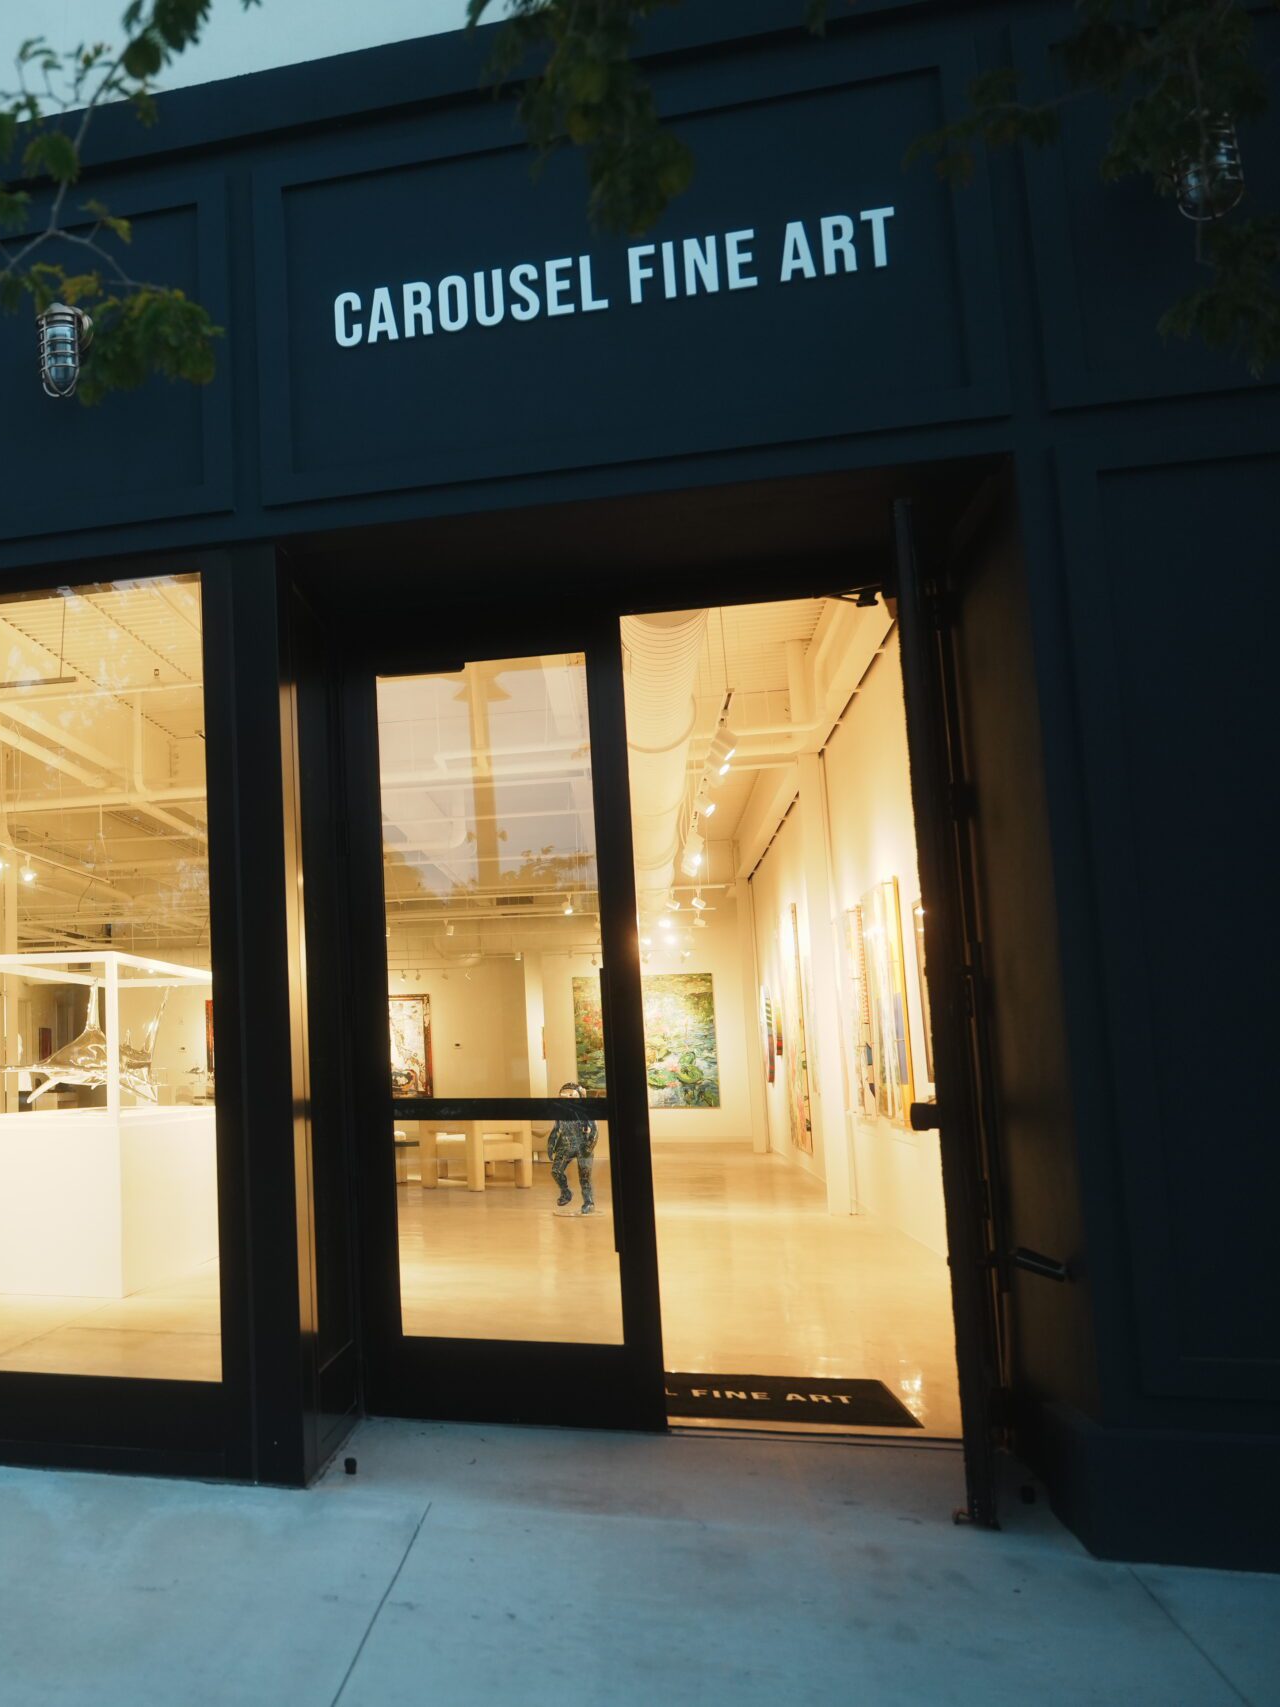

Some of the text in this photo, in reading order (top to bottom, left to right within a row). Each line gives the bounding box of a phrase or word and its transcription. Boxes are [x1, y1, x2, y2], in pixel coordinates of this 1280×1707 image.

[333, 206, 895, 348] CAROUSEL FINE ART
[690, 1388, 771, 1401] FINE
[785, 1392, 853, 1405] ART
